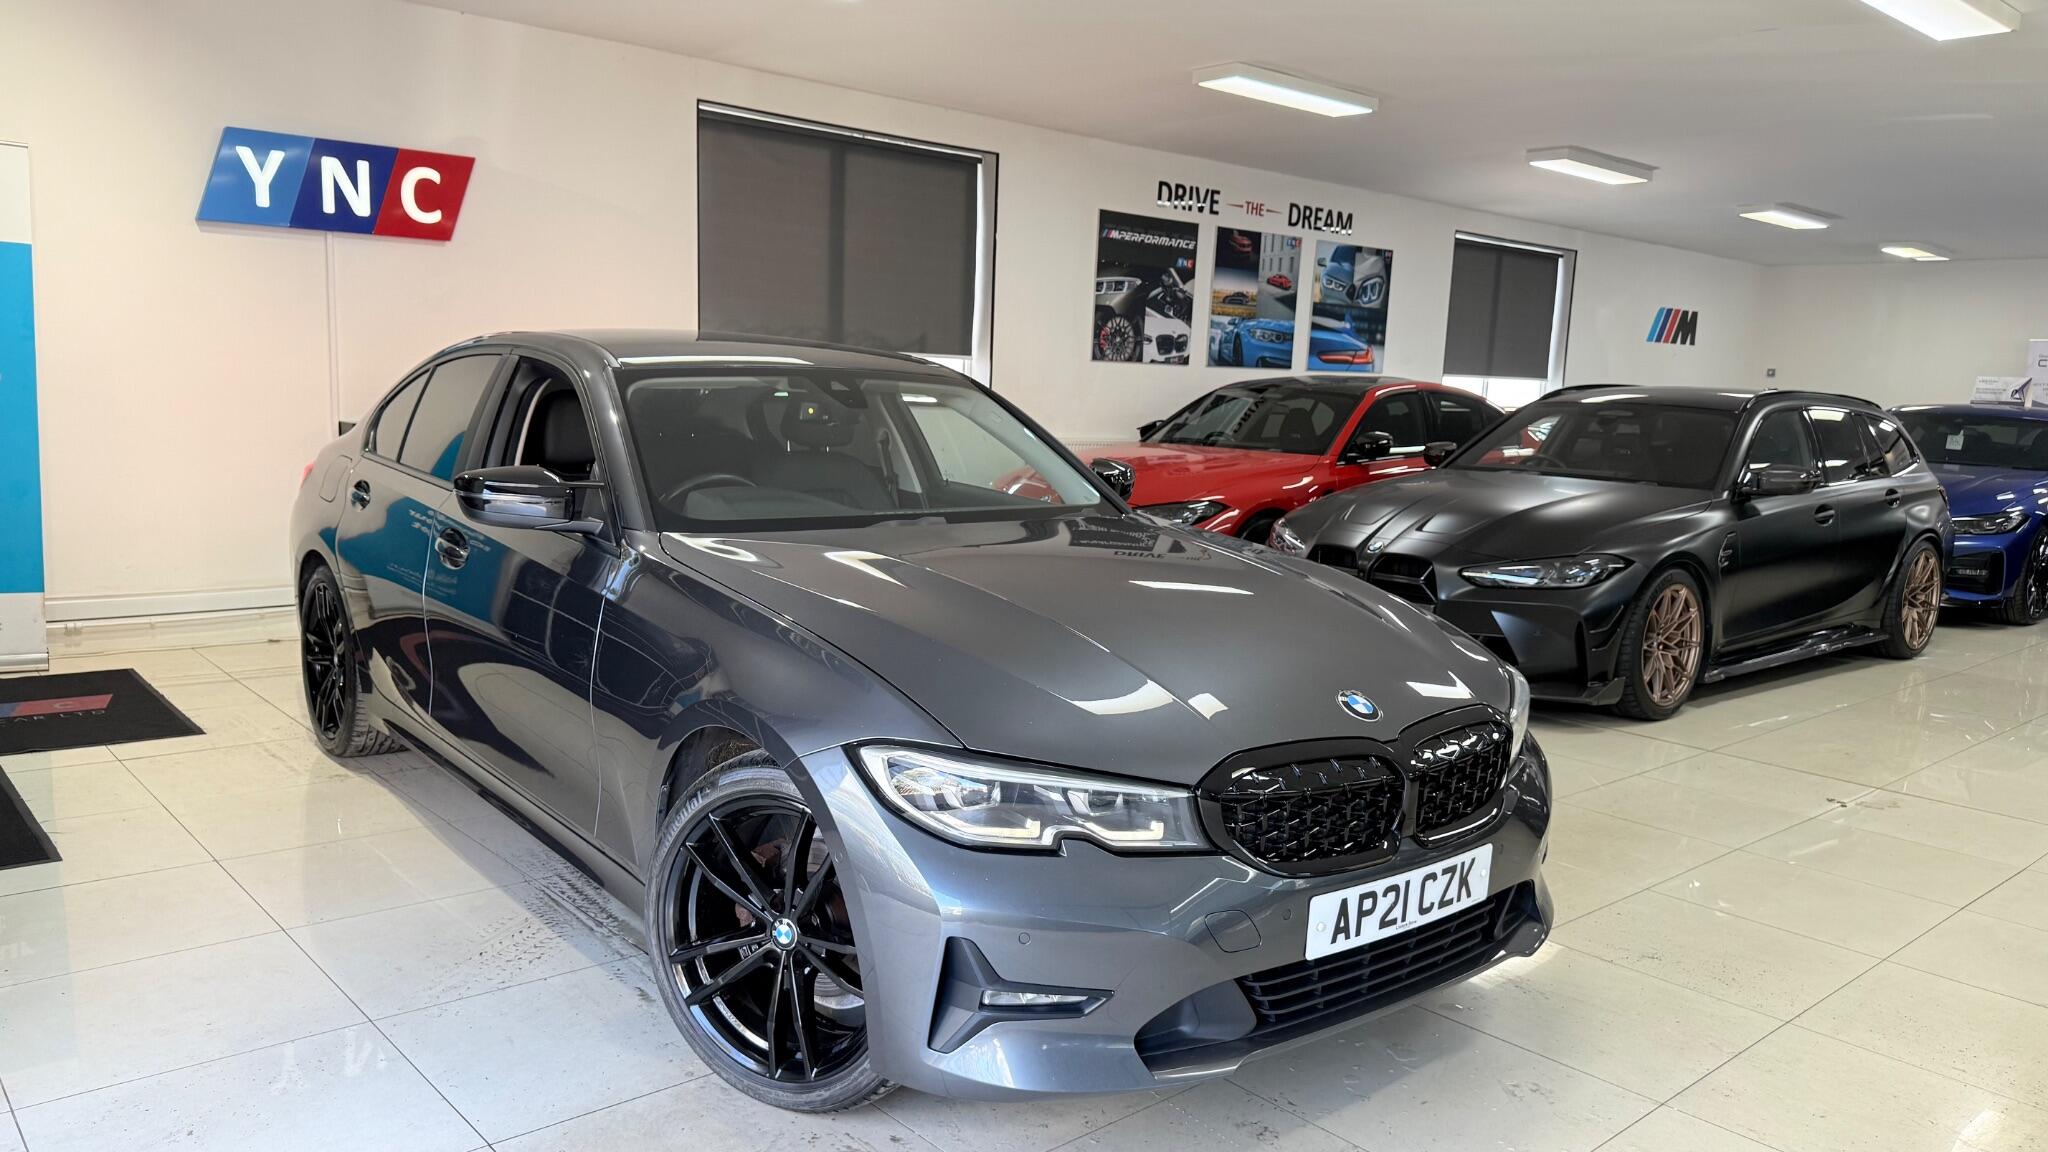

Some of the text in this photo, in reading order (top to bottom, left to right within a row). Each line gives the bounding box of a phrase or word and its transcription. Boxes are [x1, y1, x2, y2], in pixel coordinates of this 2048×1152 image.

[234, 145, 443, 224] YNC
[1156, 180, 1354, 236] DRIVE THE DREAM
[1330, 857, 1476, 945] AP21 CZK
